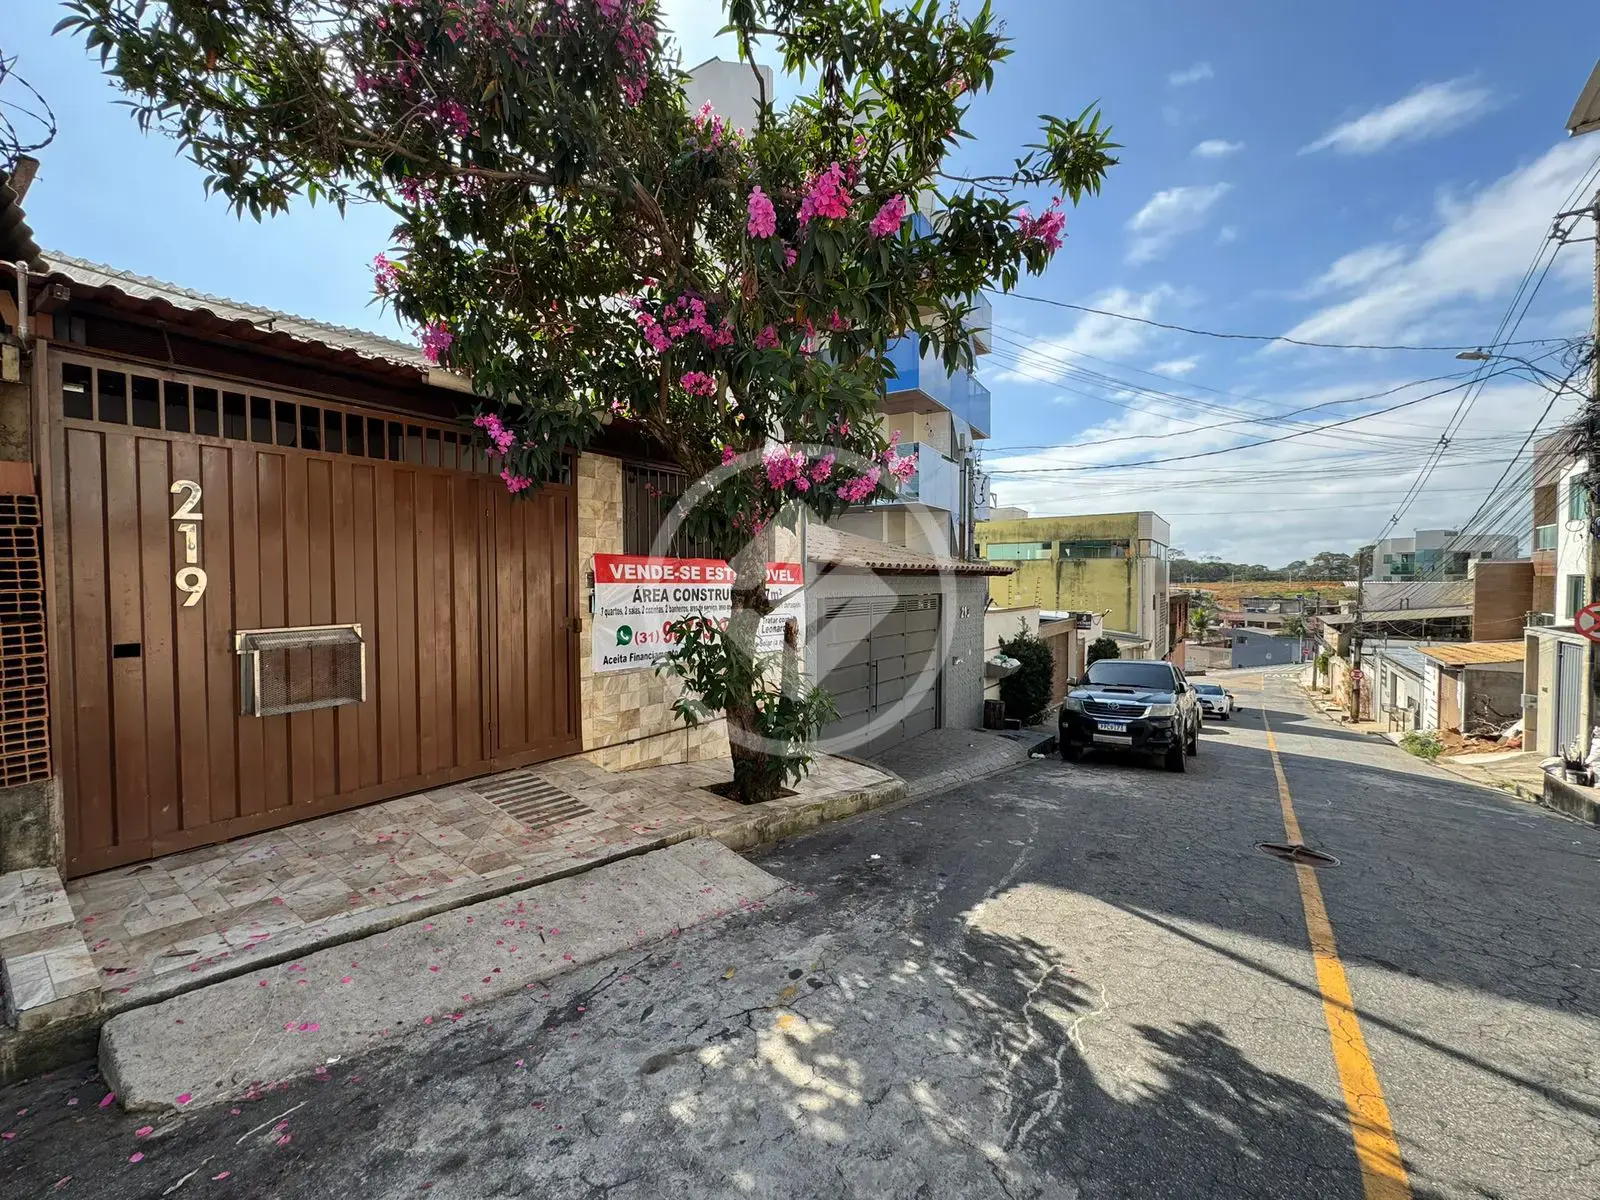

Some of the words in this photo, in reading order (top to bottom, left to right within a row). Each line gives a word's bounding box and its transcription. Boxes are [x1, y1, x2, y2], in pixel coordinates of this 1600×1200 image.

[170, 479, 208, 607] 219
[608, 563, 701, 580] VENDE-SE
[632, 585, 669, 603] ÁREA
[673, 588, 730, 602] CONSTRU
[634, 630, 660, 645] (31)
[602, 653, 627, 665] Aceita
